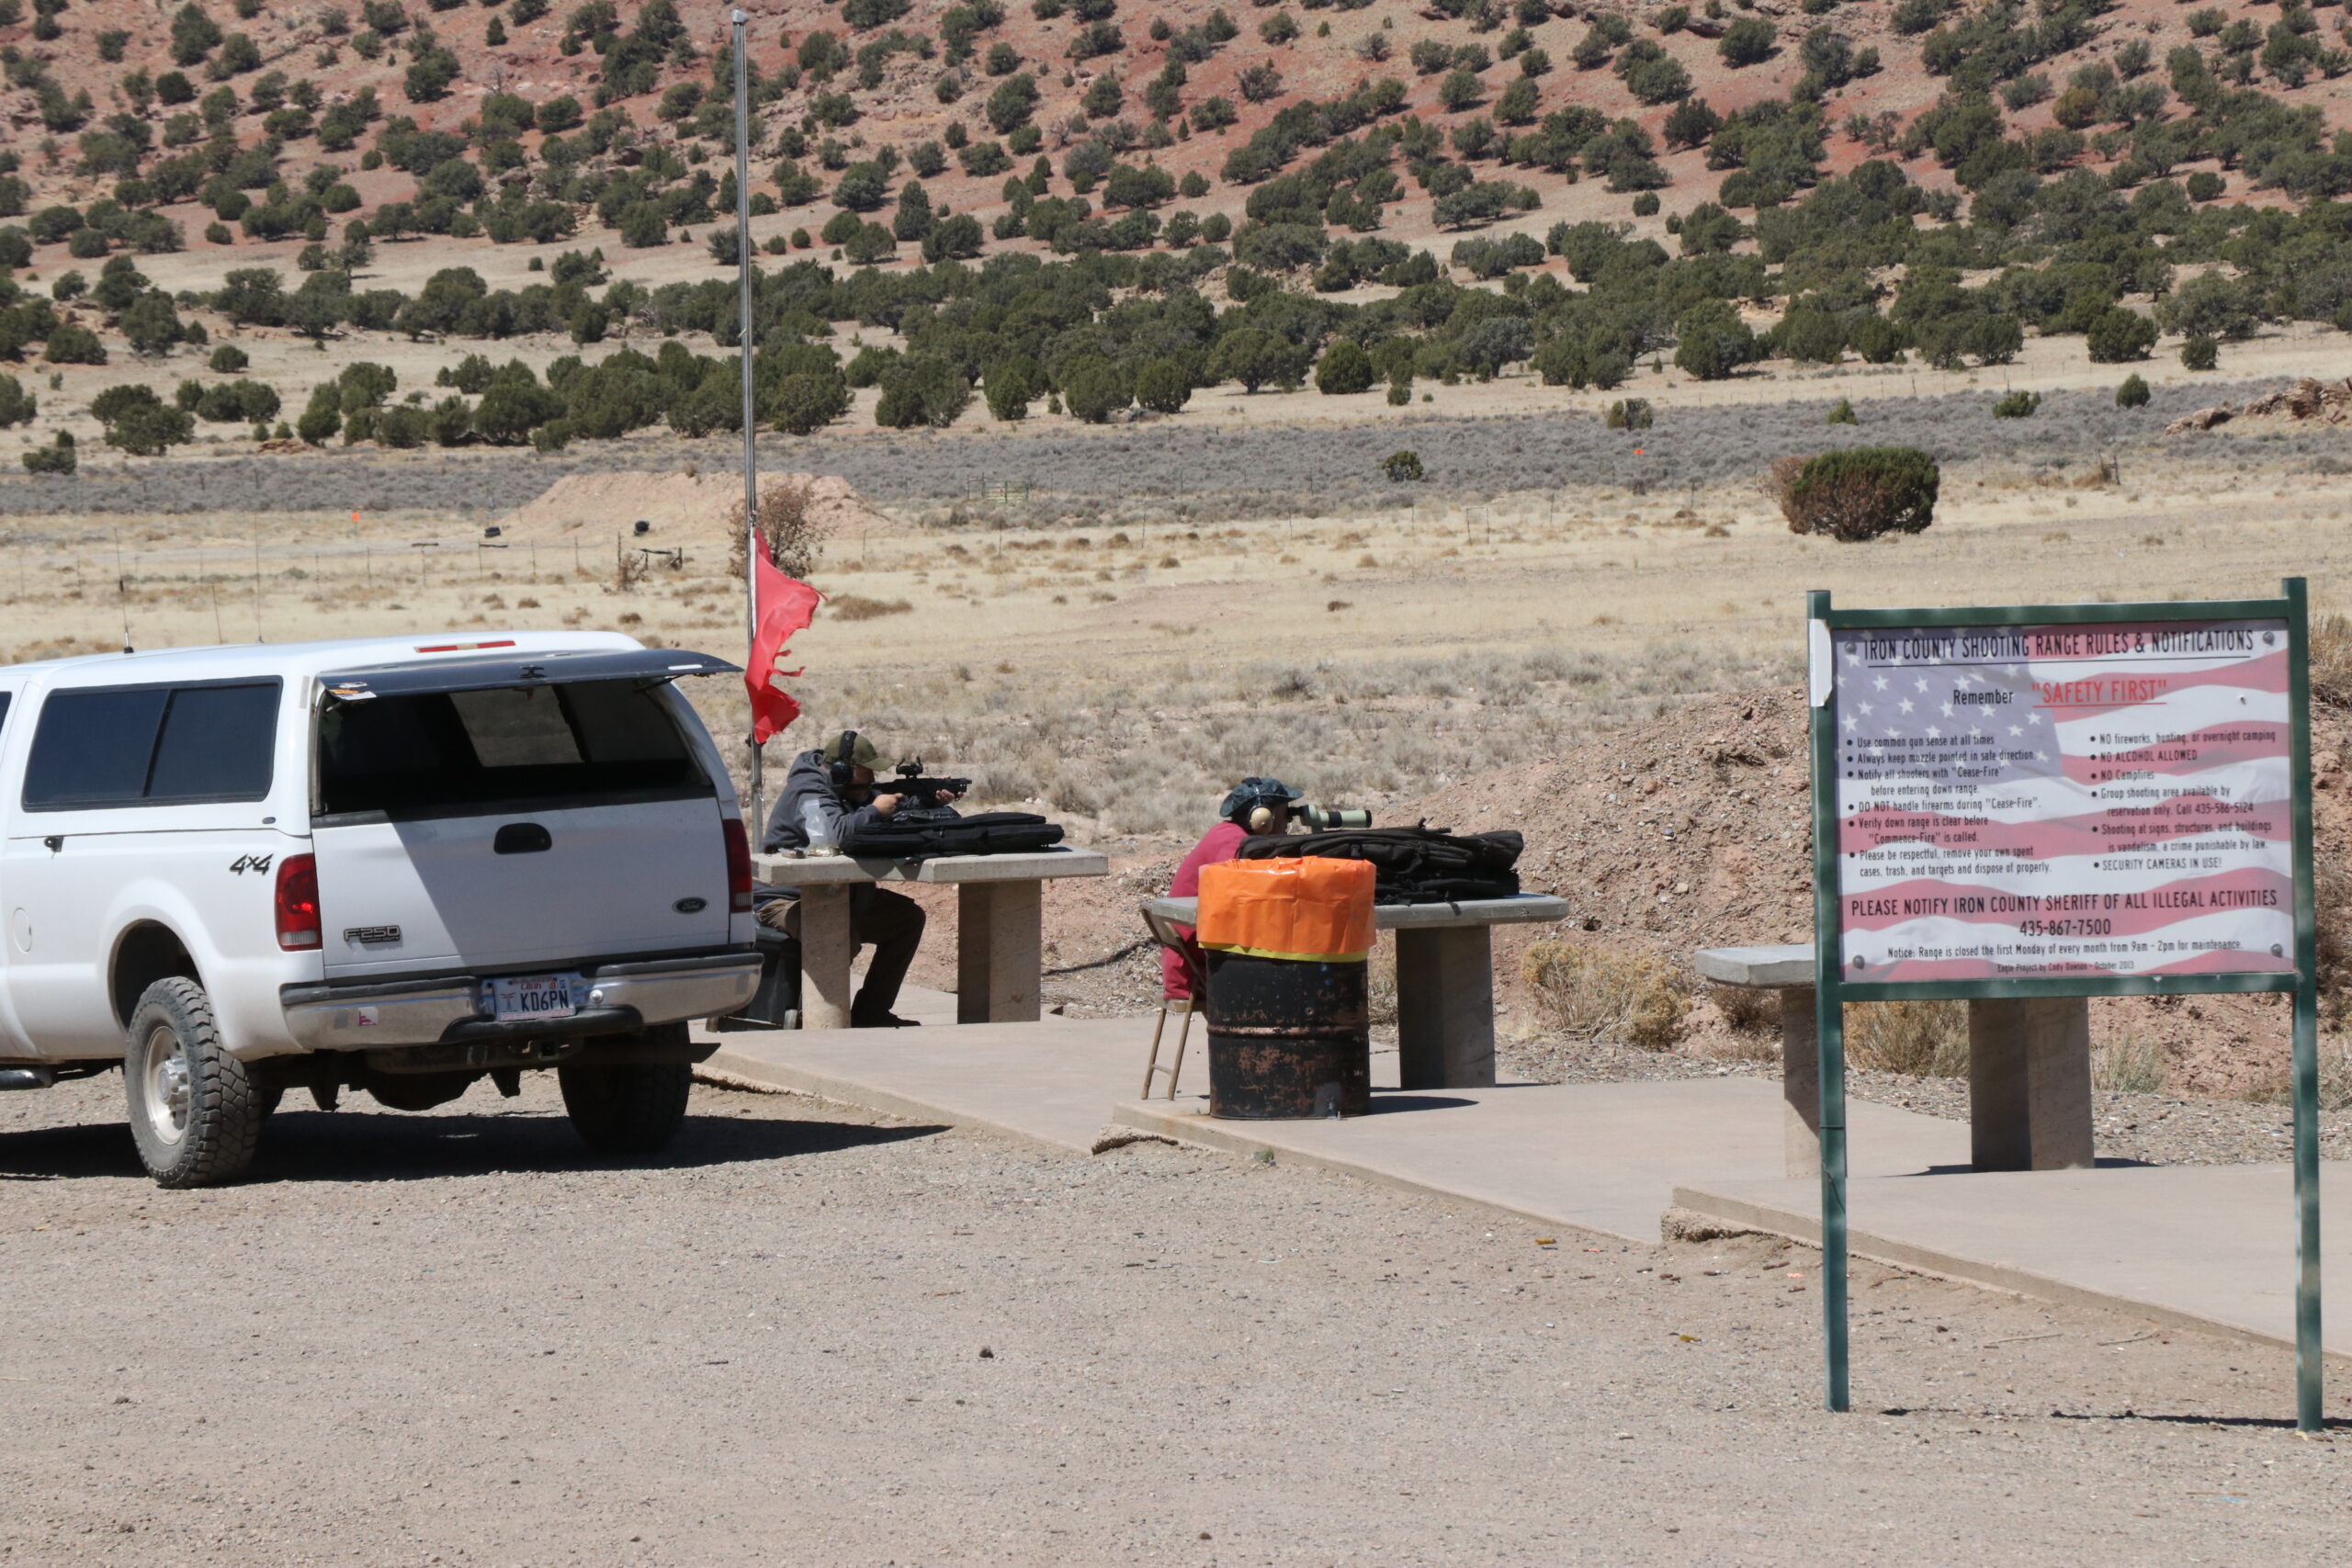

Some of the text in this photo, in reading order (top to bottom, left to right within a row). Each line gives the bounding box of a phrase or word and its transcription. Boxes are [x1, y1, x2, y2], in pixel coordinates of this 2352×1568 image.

[1864, 629, 2253, 660] IRON COUNTY SHOOTING RANGE RULES & NOTIFICATIONS
[1953, 689, 2014, 705] Remember
[2031, 679, 2167, 704] "SAFETY FIRST"
[1857, 735, 1995, 750] Use common gun sense at all times
[2099, 734, 2111, 744] NO
[2192, 733, 2199, 742] or
[2203, 731, 2239, 744] overnight
[2242, 730, 2276, 742] camping
[1858, 753, 1884, 764] Always
[1887, 753, 1905, 764] keep
[1908, 752, 1936, 762] muzzle
[1939, 750, 1967, 764] pointed
[1970, 750, 1977, 761] in
[1981, 750, 1996, 761] safe
[2100, 750, 2198, 762] NO ALCOHOL ALLOWED
[1858, 766, 2005, 781] Notify all shooters with "Cease-Fire"
[2100, 770, 2154, 782] NO Campfires
[1871, 785, 1894, 795] before
[1897, 785, 1929, 797] entering
[1933, 784, 1952, 795] down
[2100, 785, 2231, 801] Group shooting area available by
[1859, 802, 1871, 812] DO
[1873, 801, 1890, 811] NOT
[1893, 800, 1919, 811] handle
[1922, 799, 1954, 811] firearms
[1956, 799, 1983, 811] during
[2107, 806, 2151, 817] reservation
[2176, 804, 2191, 815] Call
[2195, 802, 2254, 814] 435-586-5124
[1859, 816, 1989, 829] Verify down range is clear before
[2101, 823, 2136, 837] Shooting
[2138, 824, 2146, 834] at
[2218, 821, 2233, 831] and
[2235, 819, 2272, 832] buildings
[1869, 832, 1940, 844] "Commence-Fire"
[1944, 832, 1951, 842] is
[2108, 843, 2115, 852] is
[2170, 840, 2191, 851] crime
[2195, 839, 2237, 852] punishable
[2240, 838, 2249, 852] by
[1860, 850, 1884, 861] Please
[1887, 850, 1897, 860] be
[1942, 849, 1972, 858] remove
[1974, 848, 1992, 860] your
[1995, 848, 2010, 857] own
[2012, 846, 2034, 858] spent
[1911, 865, 1926, 875] and
[1928, 864, 1955, 877] targets
[1958, 863, 1972, 874] and
[1975, 863, 2003, 875] dispose
[2006, 862, 2014, 873] of
[2102, 857, 2222, 871] SECURITY CAMERAS IN USE!
[1851, 889, 2278, 916] PLEASE NOTIFY IRON COUNTY SHERIFF OF ALL ILLEGAL ACTIVITIES
[2019, 919, 2111, 937] 435-867-7500
[1888, 947, 1915, 958] Notice:
[1918, 947, 1942, 960] Range
[1945, 946, 1951, 956] is
[1954, 945, 1978, 956] closed
[1982, 945, 1995, 955] the
[1996, 944, 2013, 954] first
[2016, 944, 2045, 956] Monday
[2048, 943, 2056, 953] of
[2059, 943, 2080, 954] every
[2084, 942, 2108, 953] month
[2109, 942, 2129, 953] from
[2132, 942, 2148, 952] 9am
[2157, 940, 2175, 953] 2pm
[2177, 940, 2188, 951] for
[1997, 964, 2014, 974] Eagle
[2016, 964, 2038, 974] Project
[2040, 964, 2046, 973] by
[2048, 963, 2064, 972] Cody
[2095, 961, 2117, 970] October
